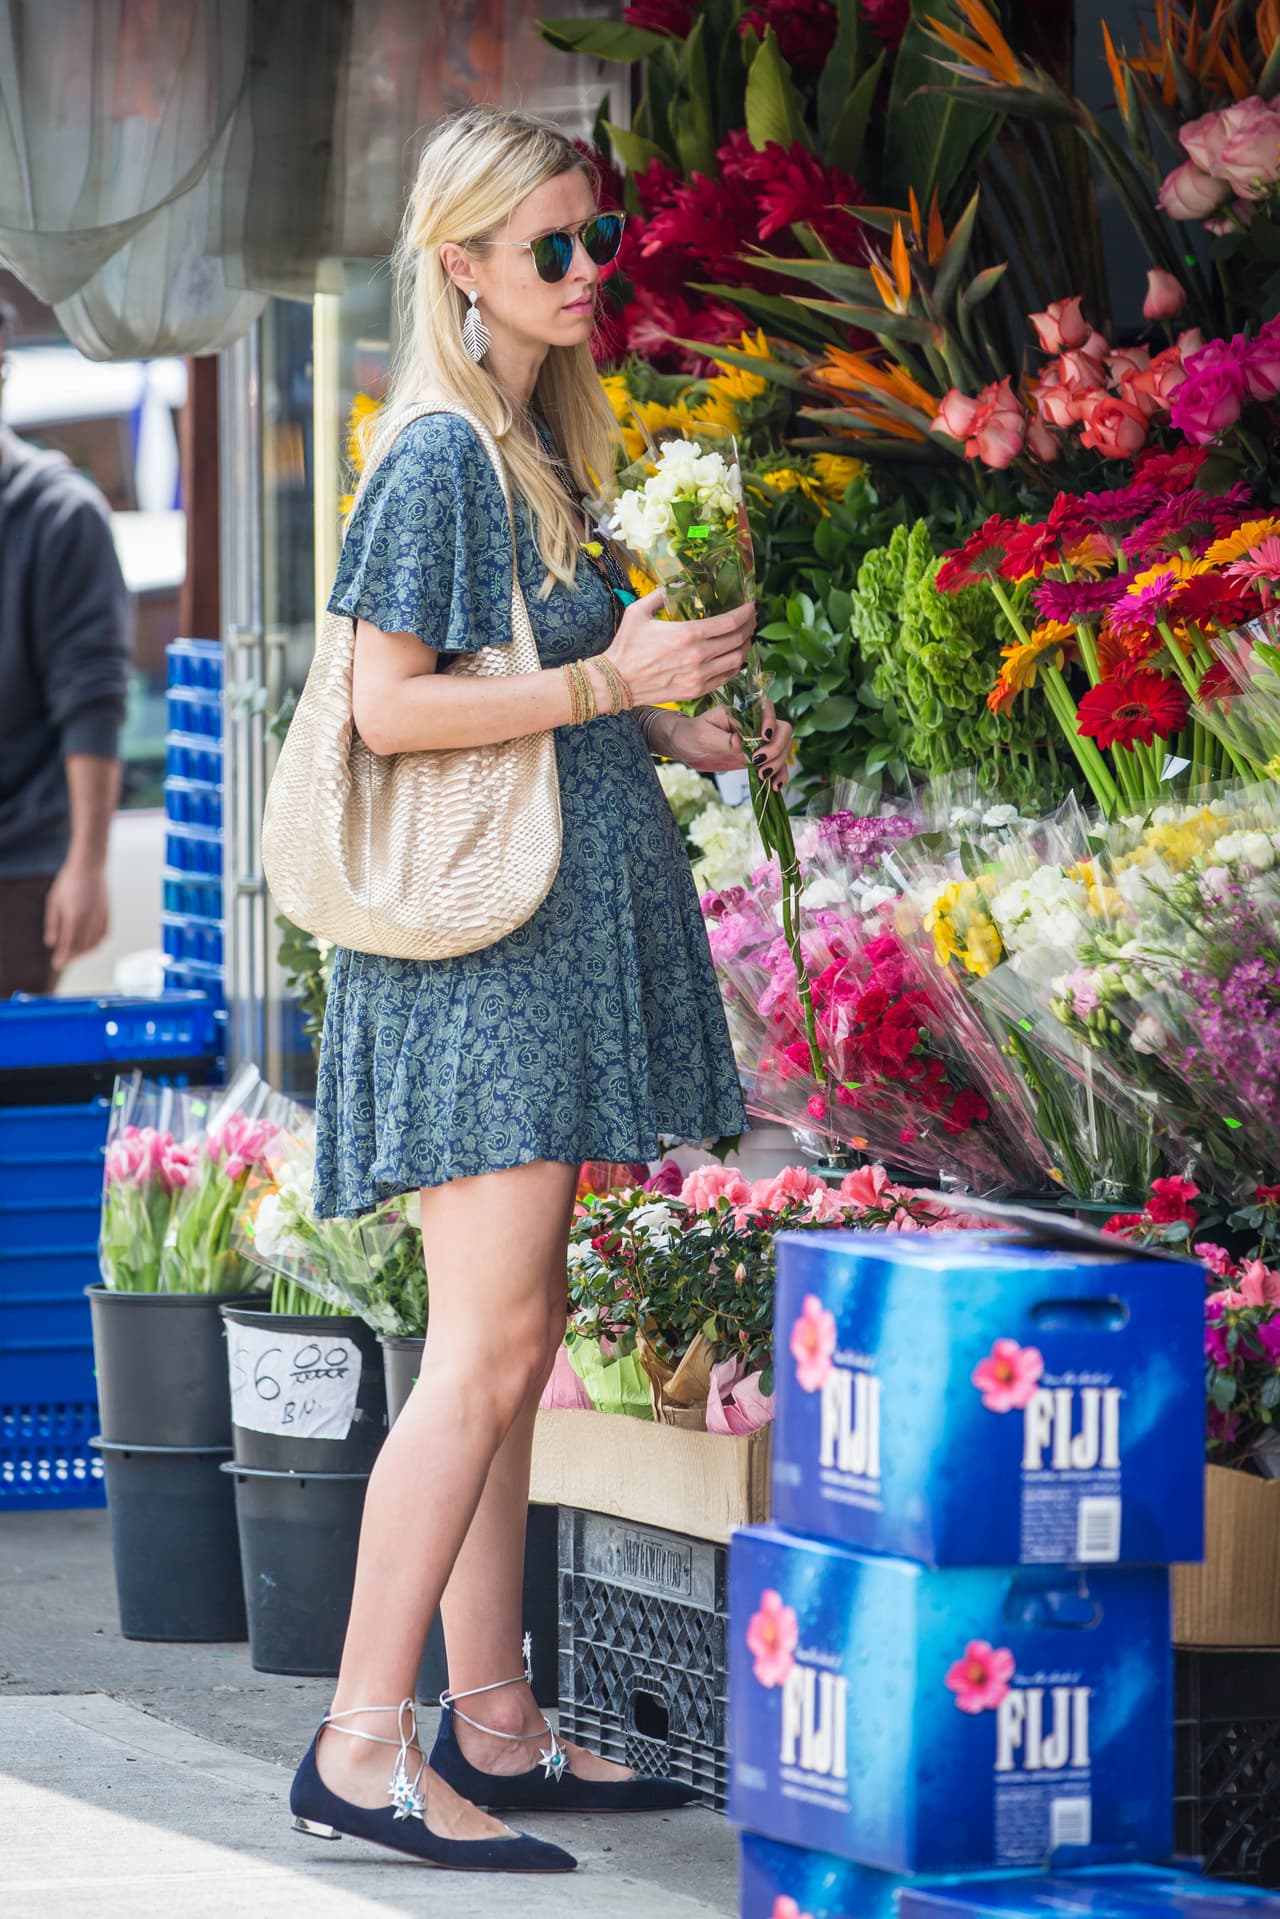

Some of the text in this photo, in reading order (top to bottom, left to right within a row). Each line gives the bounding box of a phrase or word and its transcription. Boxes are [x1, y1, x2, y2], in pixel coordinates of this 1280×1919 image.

[820, 1369, 881, 1477] FIJI
[1021, 1387, 1121, 1470] FIJI
[780, 1666, 848, 1778] FIJI
[994, 1686, 1091, 1771] FIJI
